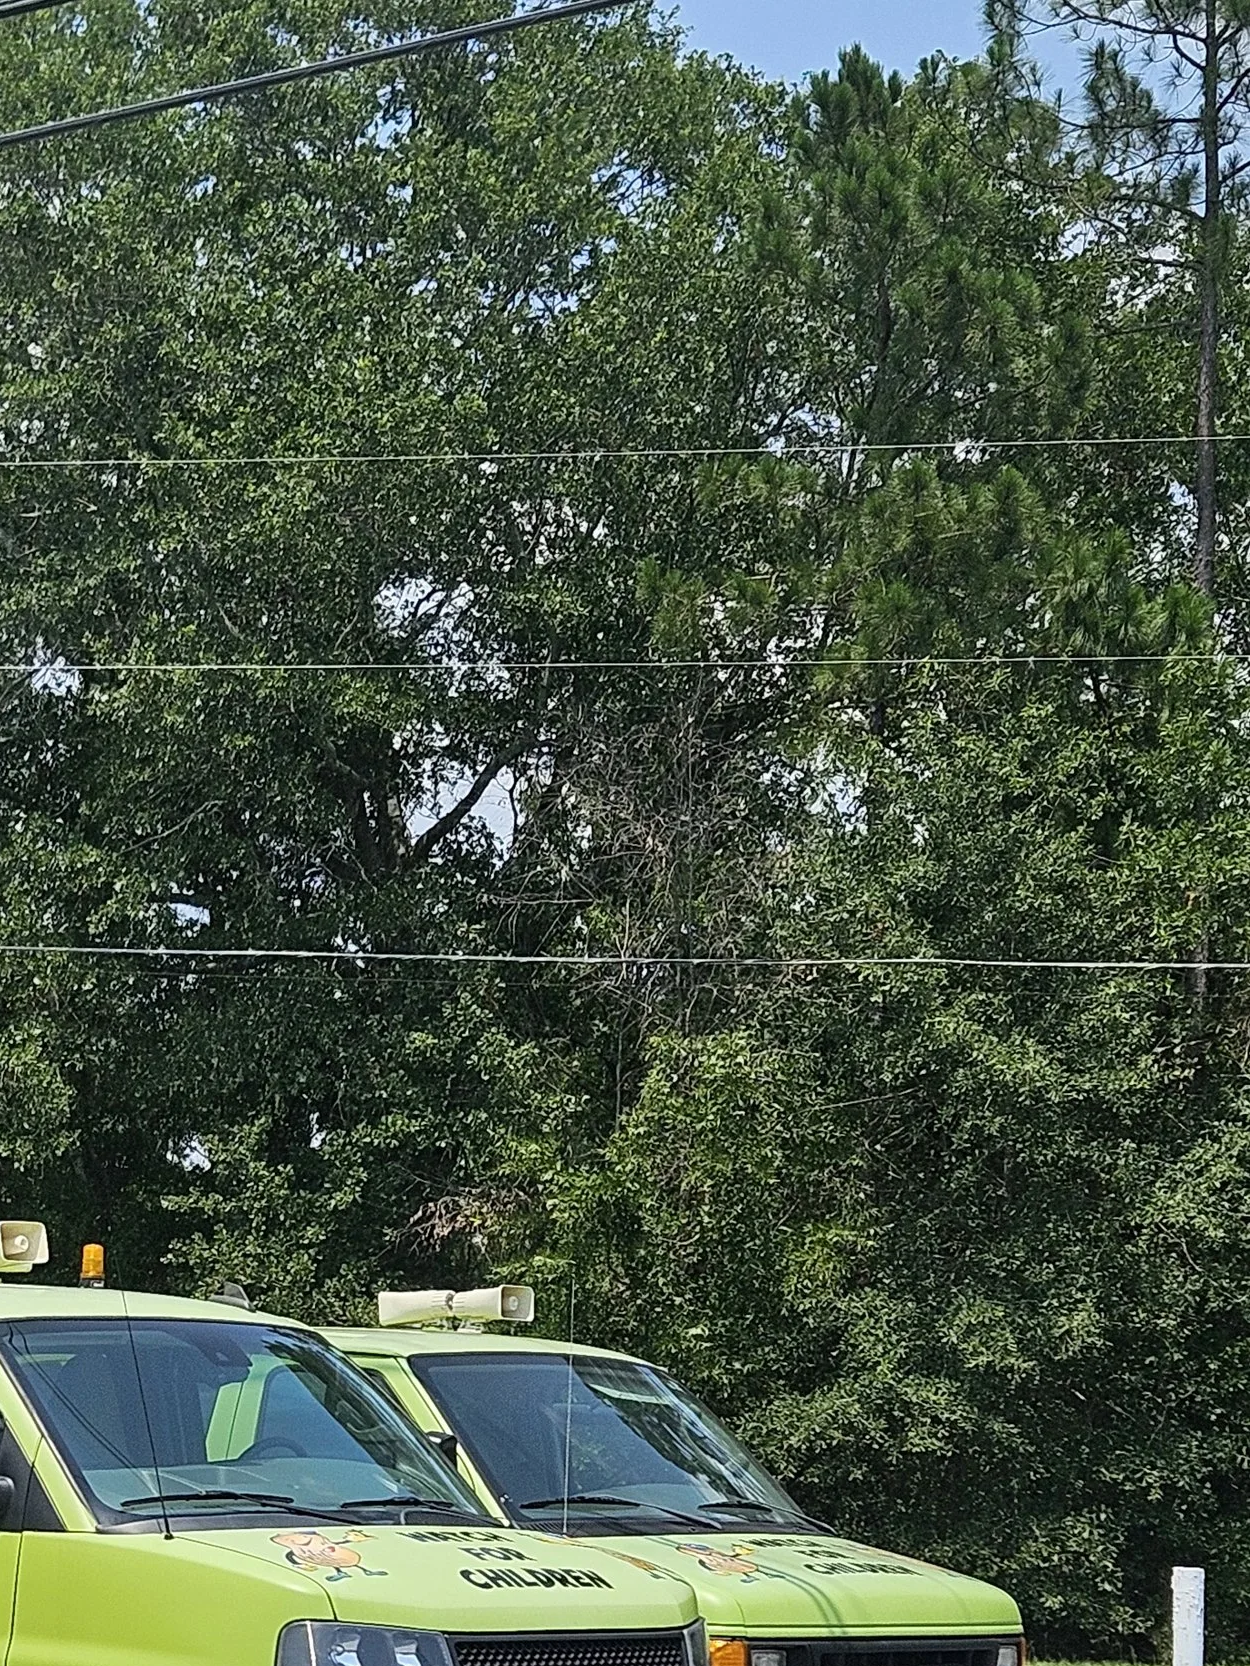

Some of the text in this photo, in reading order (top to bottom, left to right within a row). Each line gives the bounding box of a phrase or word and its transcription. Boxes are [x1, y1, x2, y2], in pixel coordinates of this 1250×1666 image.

[396, 1531, 514, 1543] WATCH
[458, 1547, 538, 1562] FOR
[459, 1567, 615, 1590] CHILDREN
